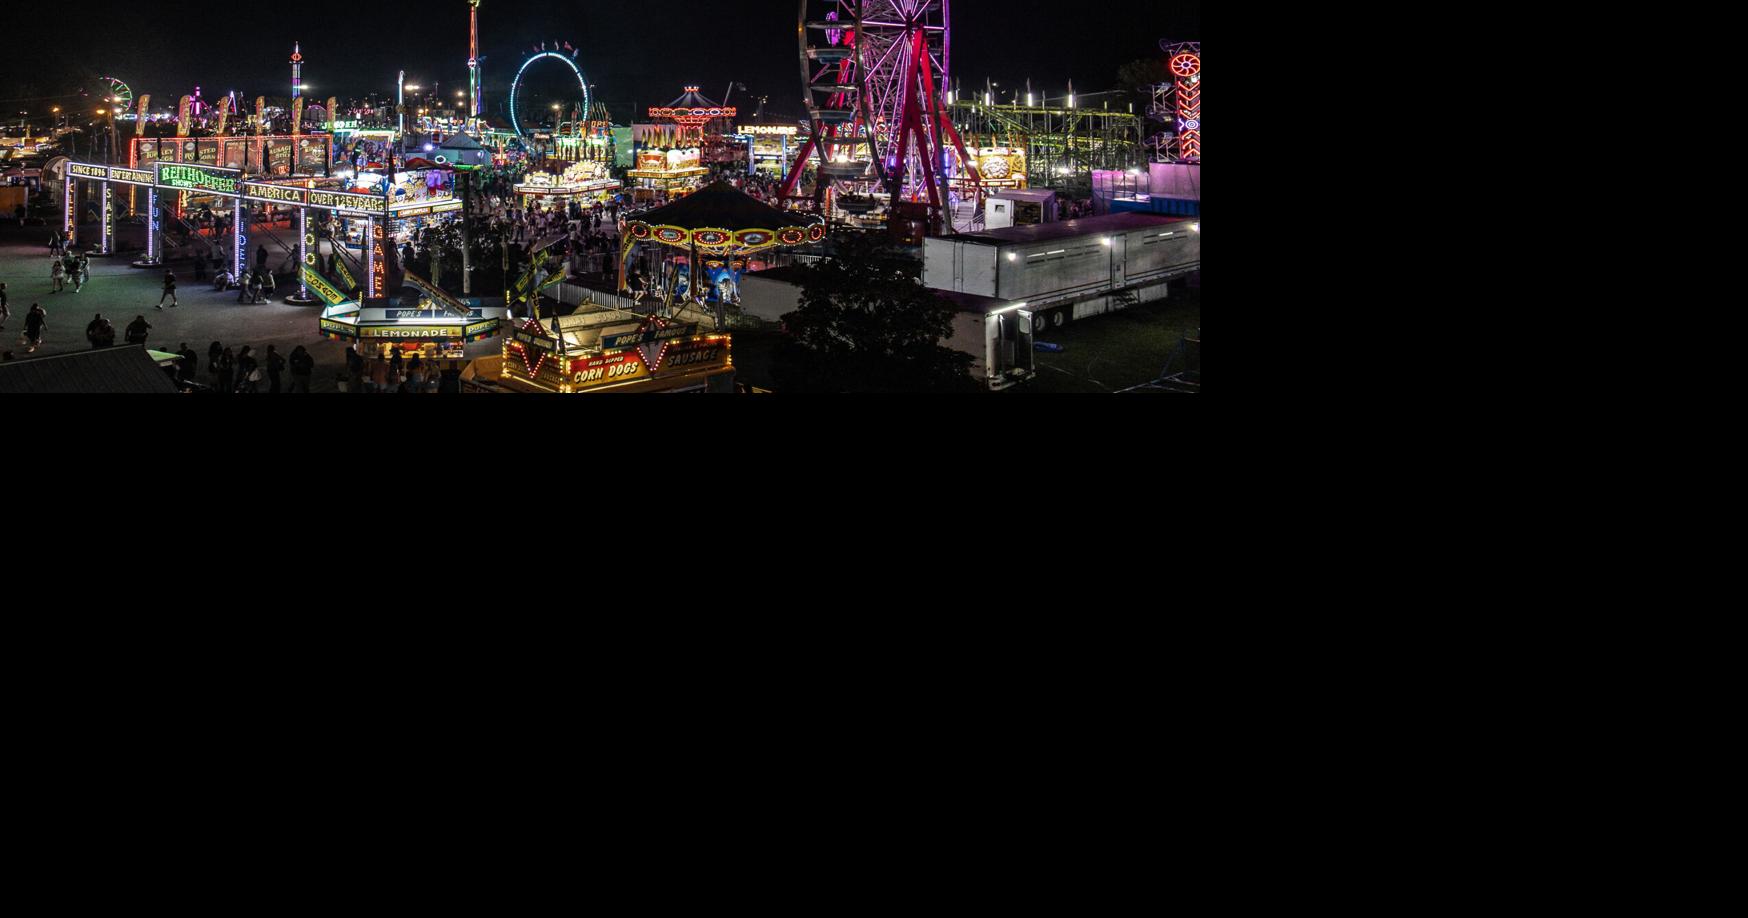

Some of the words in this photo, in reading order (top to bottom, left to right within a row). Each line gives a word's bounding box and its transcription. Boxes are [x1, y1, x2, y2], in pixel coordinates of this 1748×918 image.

[738, 126, 797, 134] LEMONADE
[72, 165, 90, 175] SINCE
[91, 168, 106, 177] 1896
[162, 167, 234, 192] REITHOFFER
[171, 179, 193, 188] SHOWS
[249, 186, 300, 201] AMERICA
[310, 191, 334, 205] OVER
[305, 216, 316, 265] FOO
[373, 223, 385, 298] GAME
[374, 328, 448, 338] LEMONADE
[615, 334, 644, 345] POPE'S
[668, 348, 718, 366] SAUSAGE
[574, 367, 604, 383] CORN
[608, 361, 638, 377] DOGS
